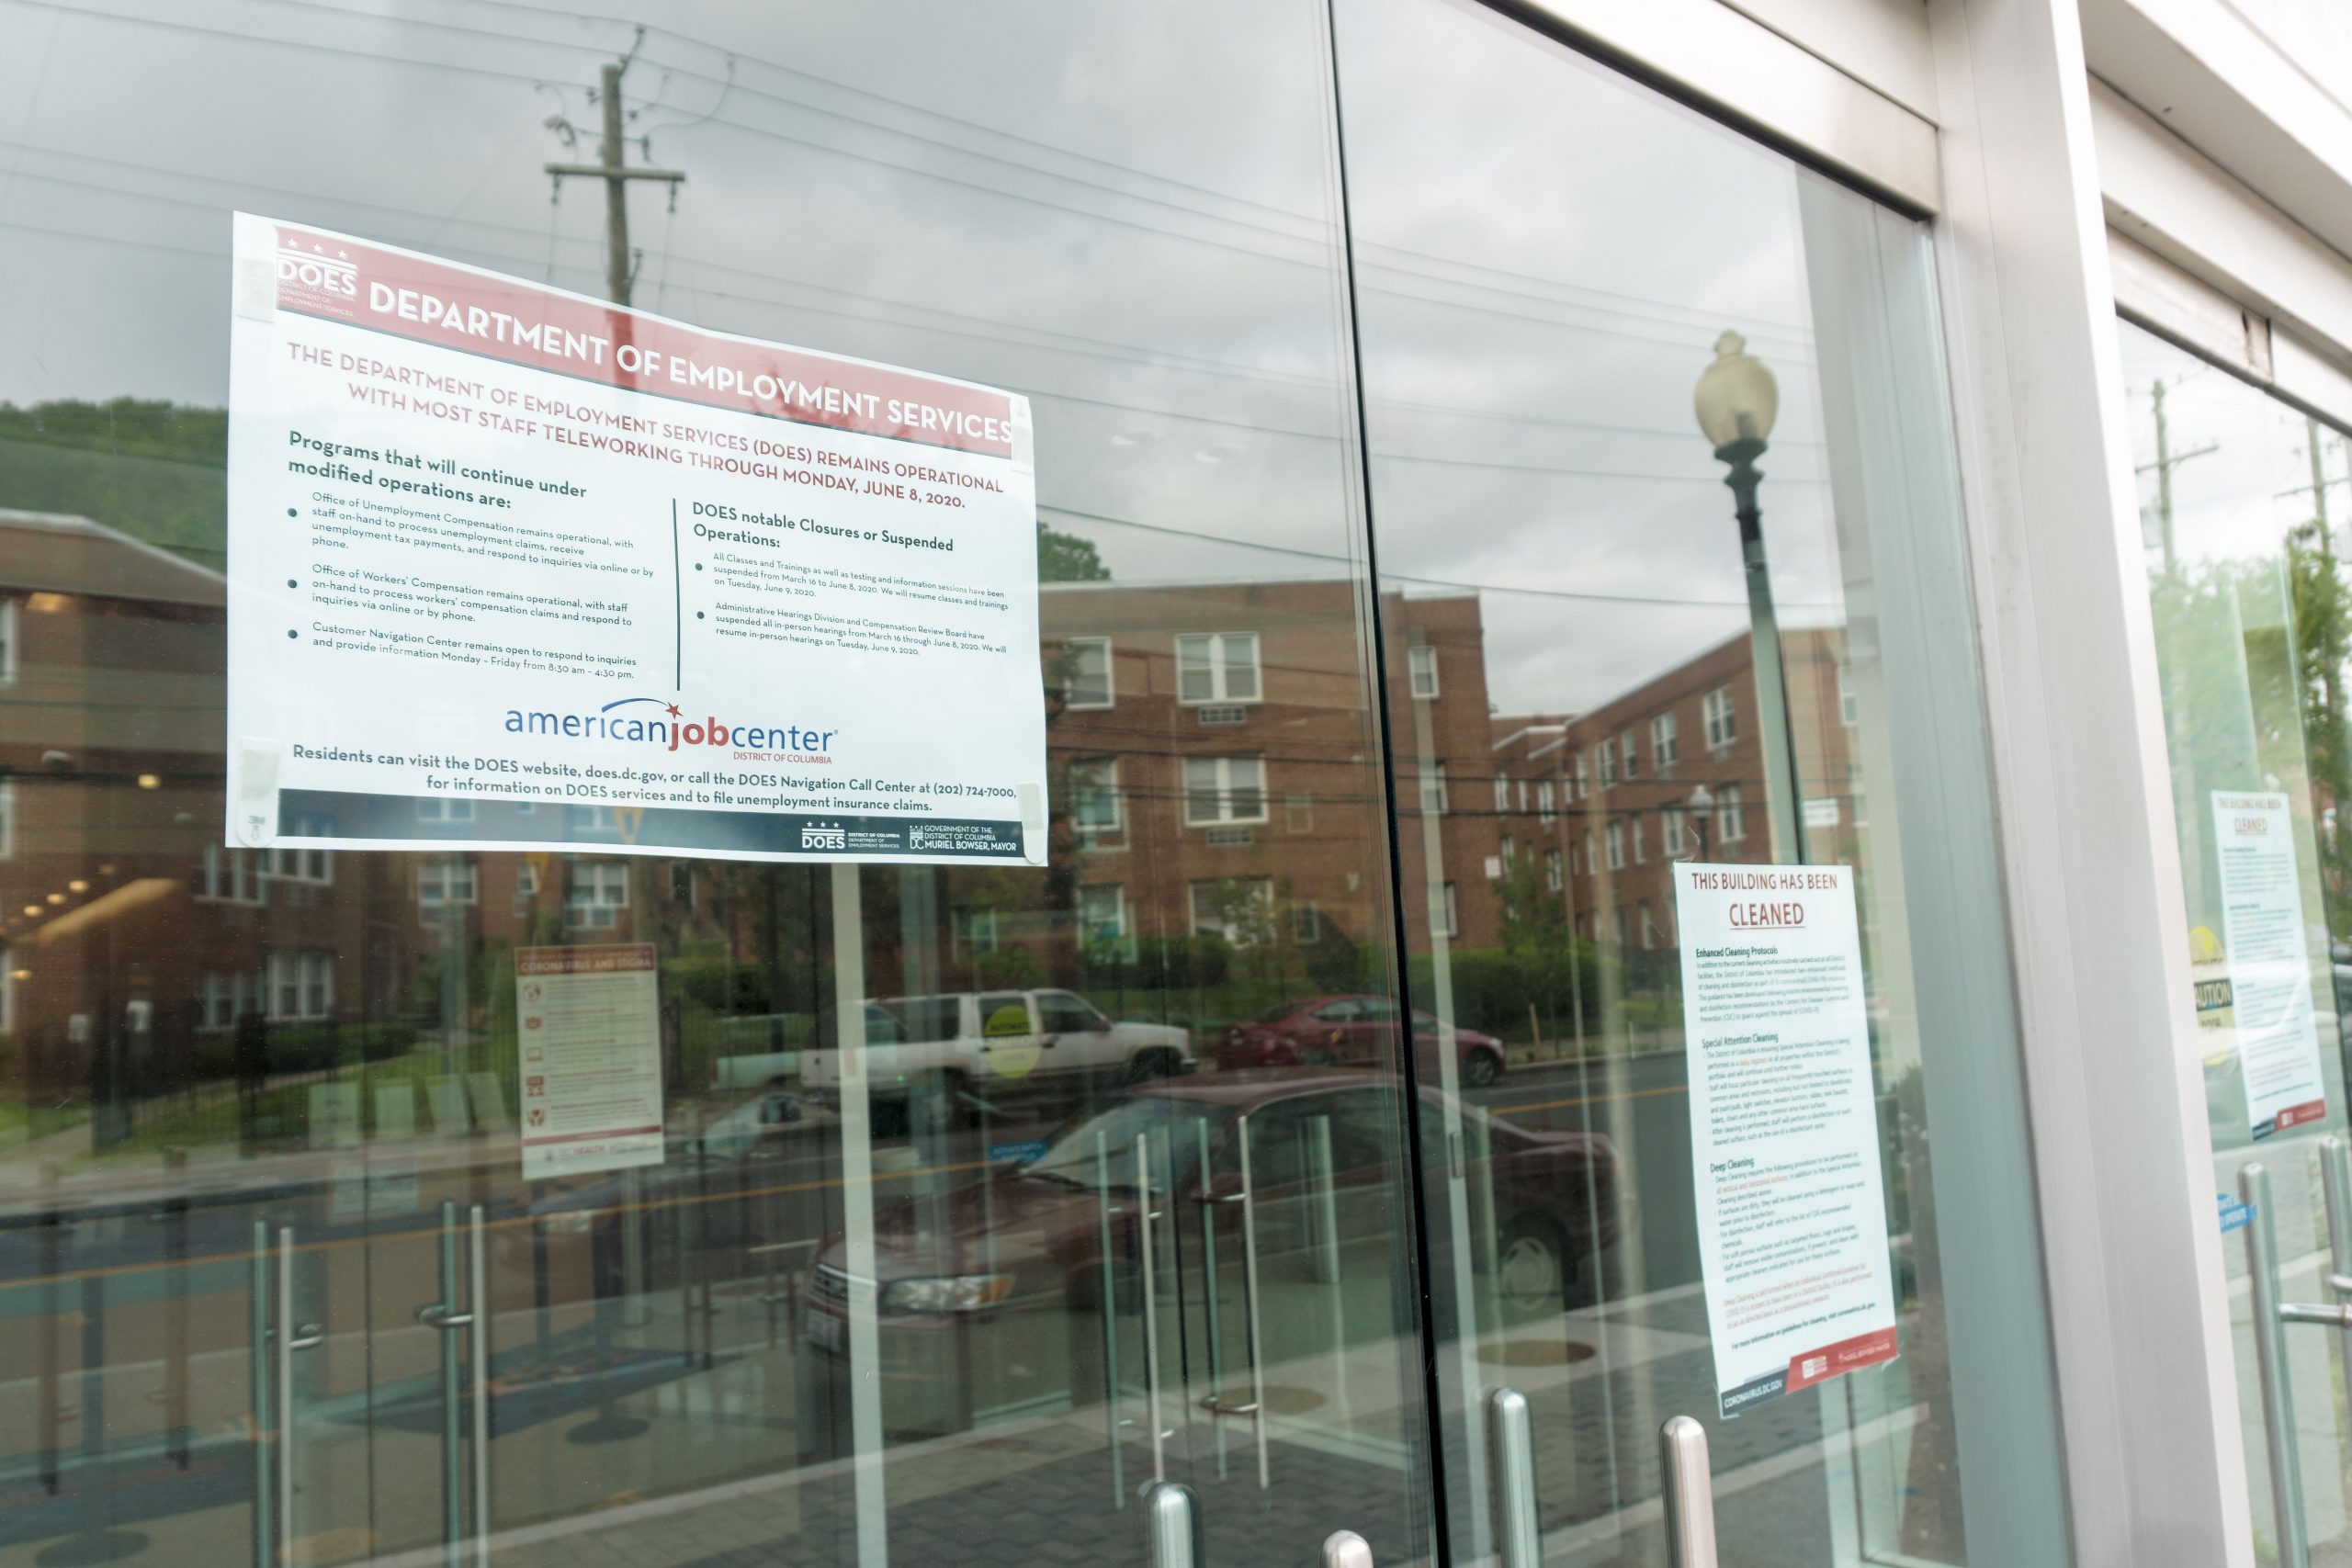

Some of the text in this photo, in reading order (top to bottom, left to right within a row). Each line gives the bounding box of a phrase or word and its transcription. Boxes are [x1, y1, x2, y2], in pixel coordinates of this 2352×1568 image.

[277, 259, 357, 295] DOES
[369, 282, 1012, 444] DEPARTMENT OF EMPLOYMENT SERVICES
[287, 342, 1004, 492] THE DEPARTMENT OF EMPLOYMENT SERVICES (DOES) REMAINS OPERATIONAL
[288, 430, 587, 497] Programs that will continue under
[347, 383, 966, 508] WITH MOST STAFF TELEWORKING THROUGH MONDAY, JUNE 8, 2020.
[288, 461, 511, 508] modified operations are:
[311, 491, 634, 548] Office of Unemployment Compensation remains operational, with
[311, 507, 584, 555] staff on-hand to process unemployment claims, receive
[692, 501, 953, 551] DOES notable Closures or Suspended
[693, 523, 780, 547] Operations:
[311, 563, 628, 612] Office of Workers' Compensation remains operational, with staff
[713, 566, 1009, 611] suspended from March 16 to June 8, 2020. We will resume classes and trainings
[311, 621, 637, 666] Customer Navigation Center remains open to respond to inquiries
[293, 743, 1016, 798] Residents can visit the DOES website, does.dc.gov, or call the DOES Navigation Call Center at (202) 724-7000,
[732, 750, 832, 764] DISTRICT OF COLUMBIA
[425, 773, 933, 811] for information on DOES services and to file unemployment insurance claims.
[802, 836, 844, 850] DOES
[922, 839, 1017, 851] MURIEL BOWSER, MAYOR
[923, 824, 993, 834] GOVERNMENT OF THE
[923, 831, 997, 842] DISTRICT OF COLUMBIA
[1690, 872, 1838, 890] THIS BUILDING HAS BEEN
[1729, 903, 1804, 927] CLEANED
[1696, 945, 1778, 958] Enhanced Cleaning Protocols
[2194, 981, 2232, 1008] AUTION
[1702, 1032, 1779, 1049] Special Attention Cleaning
[1710, 1156, 1755, 1176] Deep Cleaning
